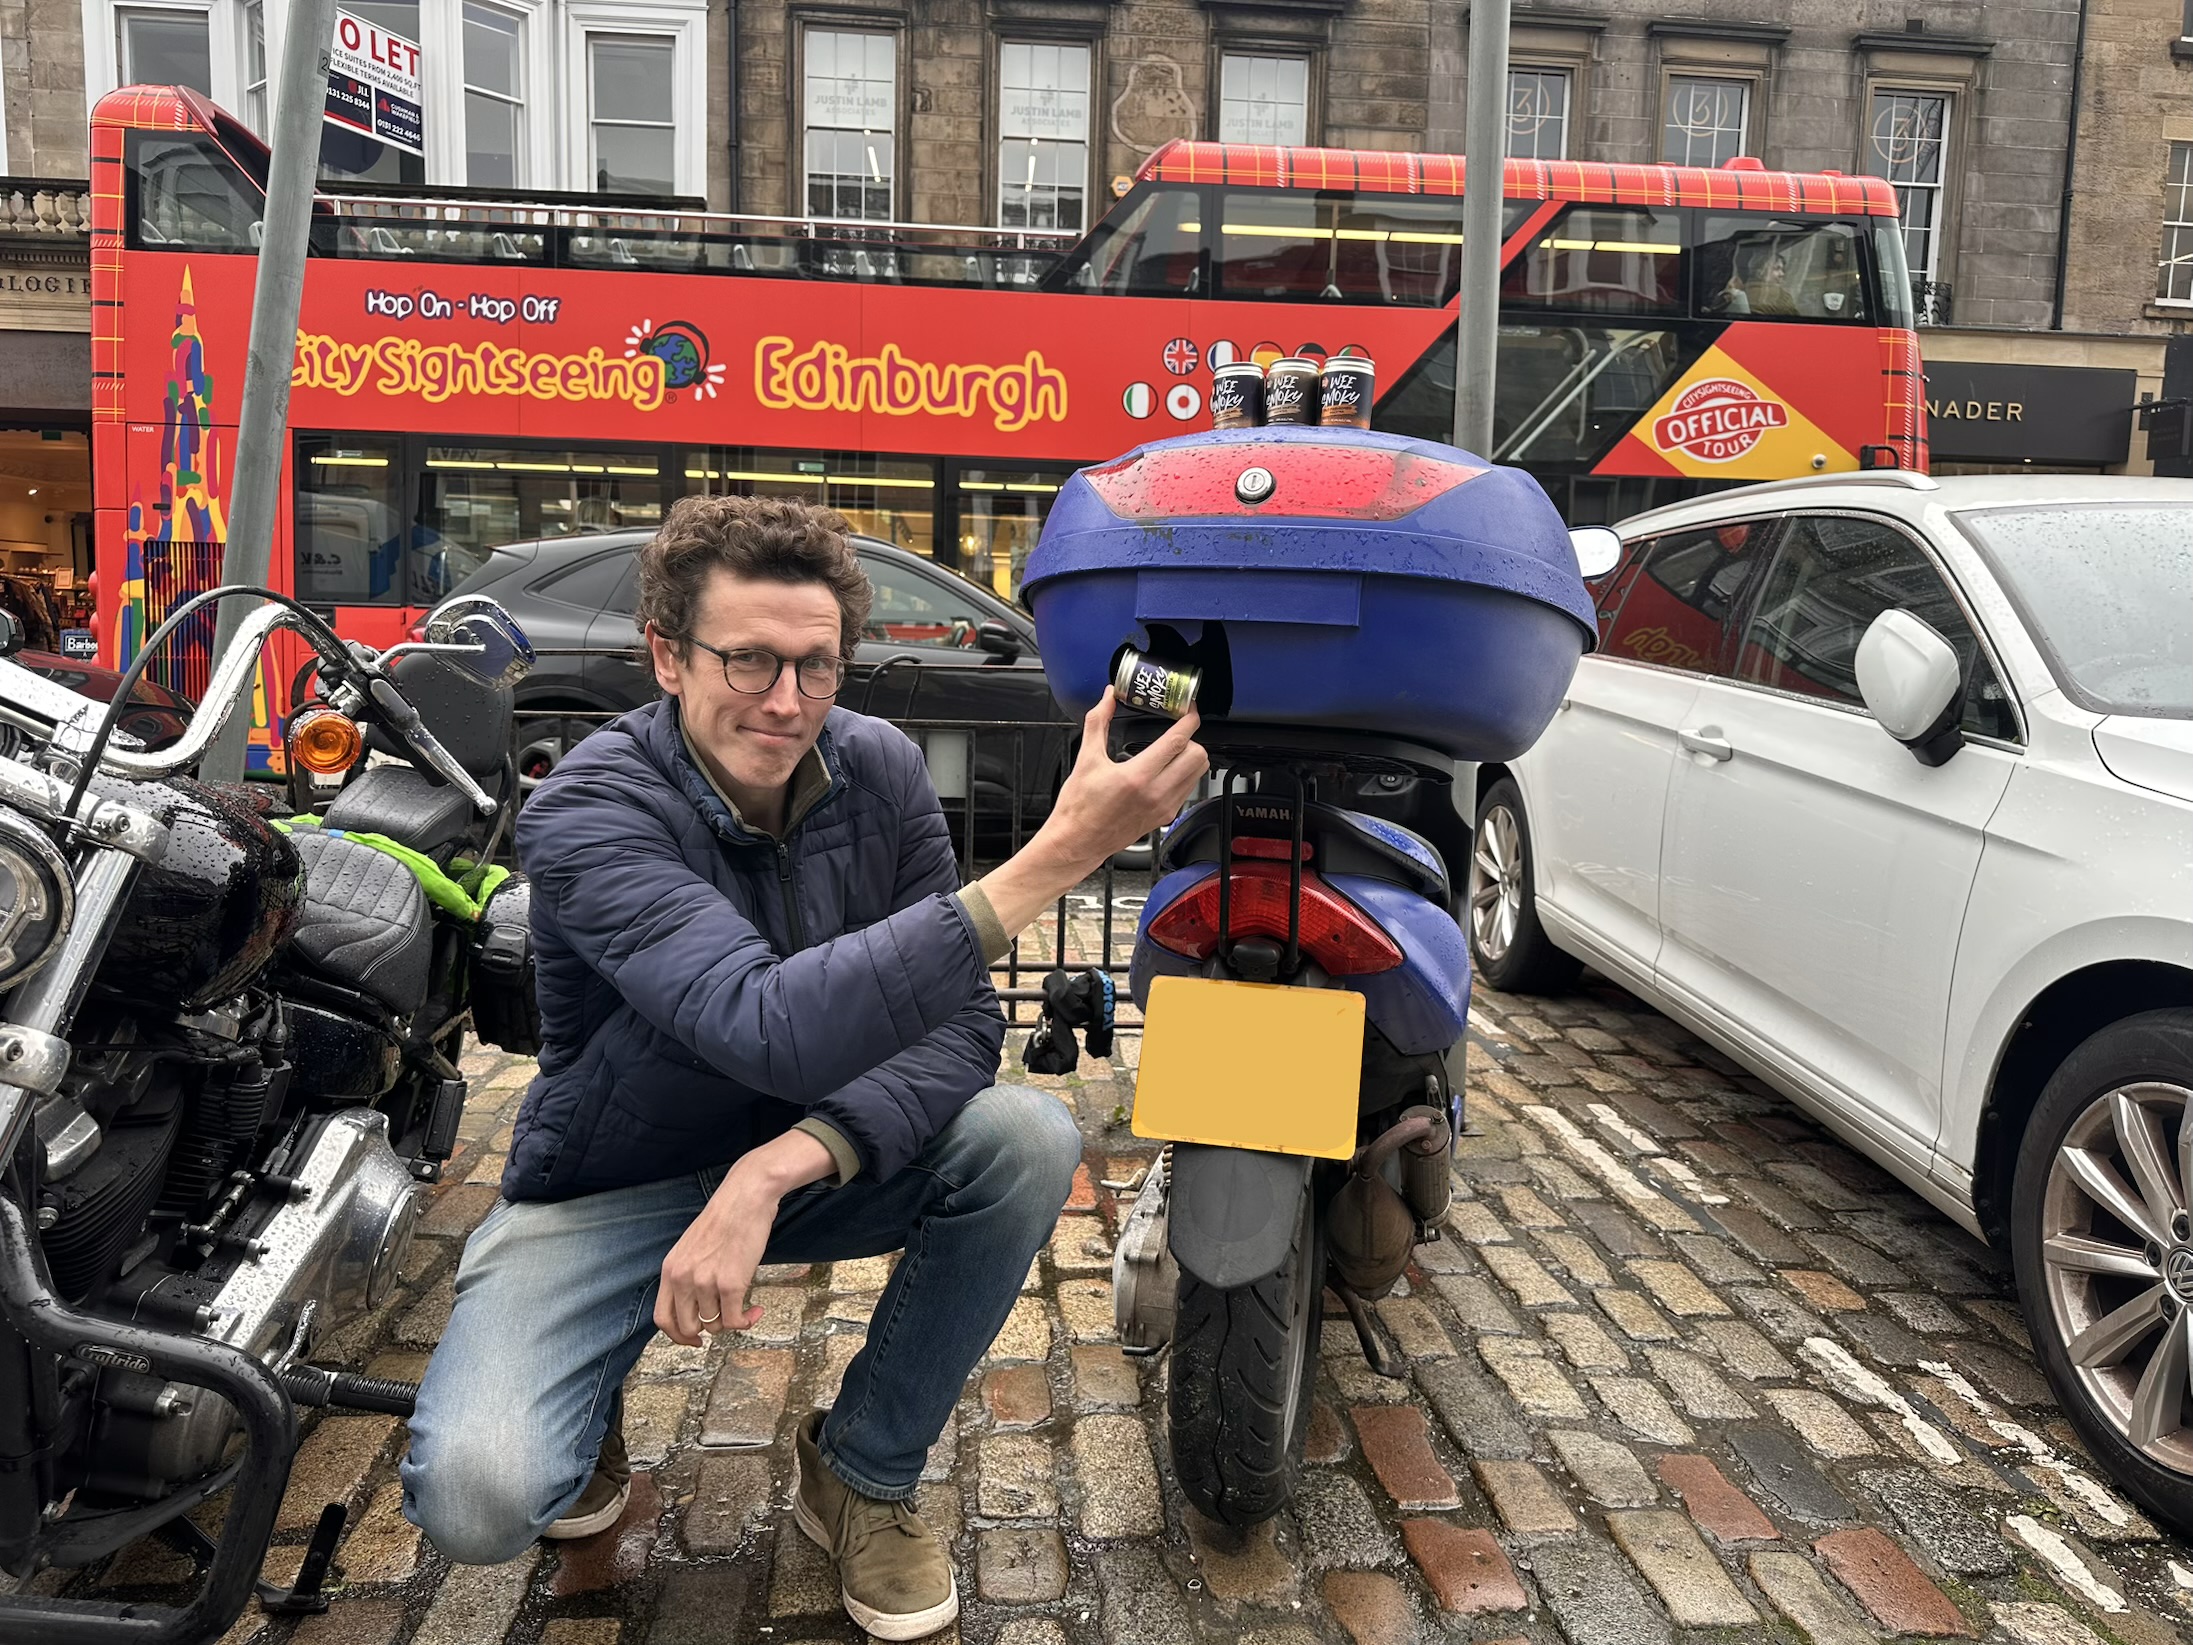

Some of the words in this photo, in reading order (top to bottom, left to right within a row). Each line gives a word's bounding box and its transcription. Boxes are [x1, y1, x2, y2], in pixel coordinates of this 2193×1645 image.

[340, 17, 361, 51] O
[370, 29, 420, 77] LET
[332, 47, 343, 58] ICE
[344, 52, 367, 69] SUITES
[368, 61, 387, 77] FROM
[356, 84, 370, 98] JLL
[360, 69, 382, 85] TERMS
[382, 79, 415, 99] AVAILABLE
[340, 92, 355, 104] 225
[353, 97, 371, 111] 8344
[814, 95, 854, 106] JUSTIN
[856, 96, 888, 108] LAMB
[1010, 105, 1050, 117] JUSTIN
[1051, 107, 1083, 119] LAMB
[376, 118, 392, 131] 0131
[391, 123, 405, 136] 222
[366, 290, 415, 320] Hop
[419, 291, 453, 319] On
[469, 294, 517, 323] Hop
[521, 295, 560, 322] Off
[755, 336, 1067, 432] Edinburgh
[1216, 378, 1239, 396] WEE
[1273, 373, 1299, 390] WEE
[1329, 373, 1357, 390] WEE
[1266, 388, 1304, 411] SMOKY
[1321, 387, 1361, 409] SMOKY
[1682, 383, 1752, 409] CITYSIGHTSEEING
[131, 425, 155, 433] WATER
[1667, 405, 1781, 444] OFFICIAL
[1703, 433, 1754, 457] TOUR
[1133, 665, 1153, 697] WEE
[1147, 665, 1169, 710] SMOKY
[1235, 805, 1293, 821] YAMAH
[80, 1346, 148, 1371] Craftride
